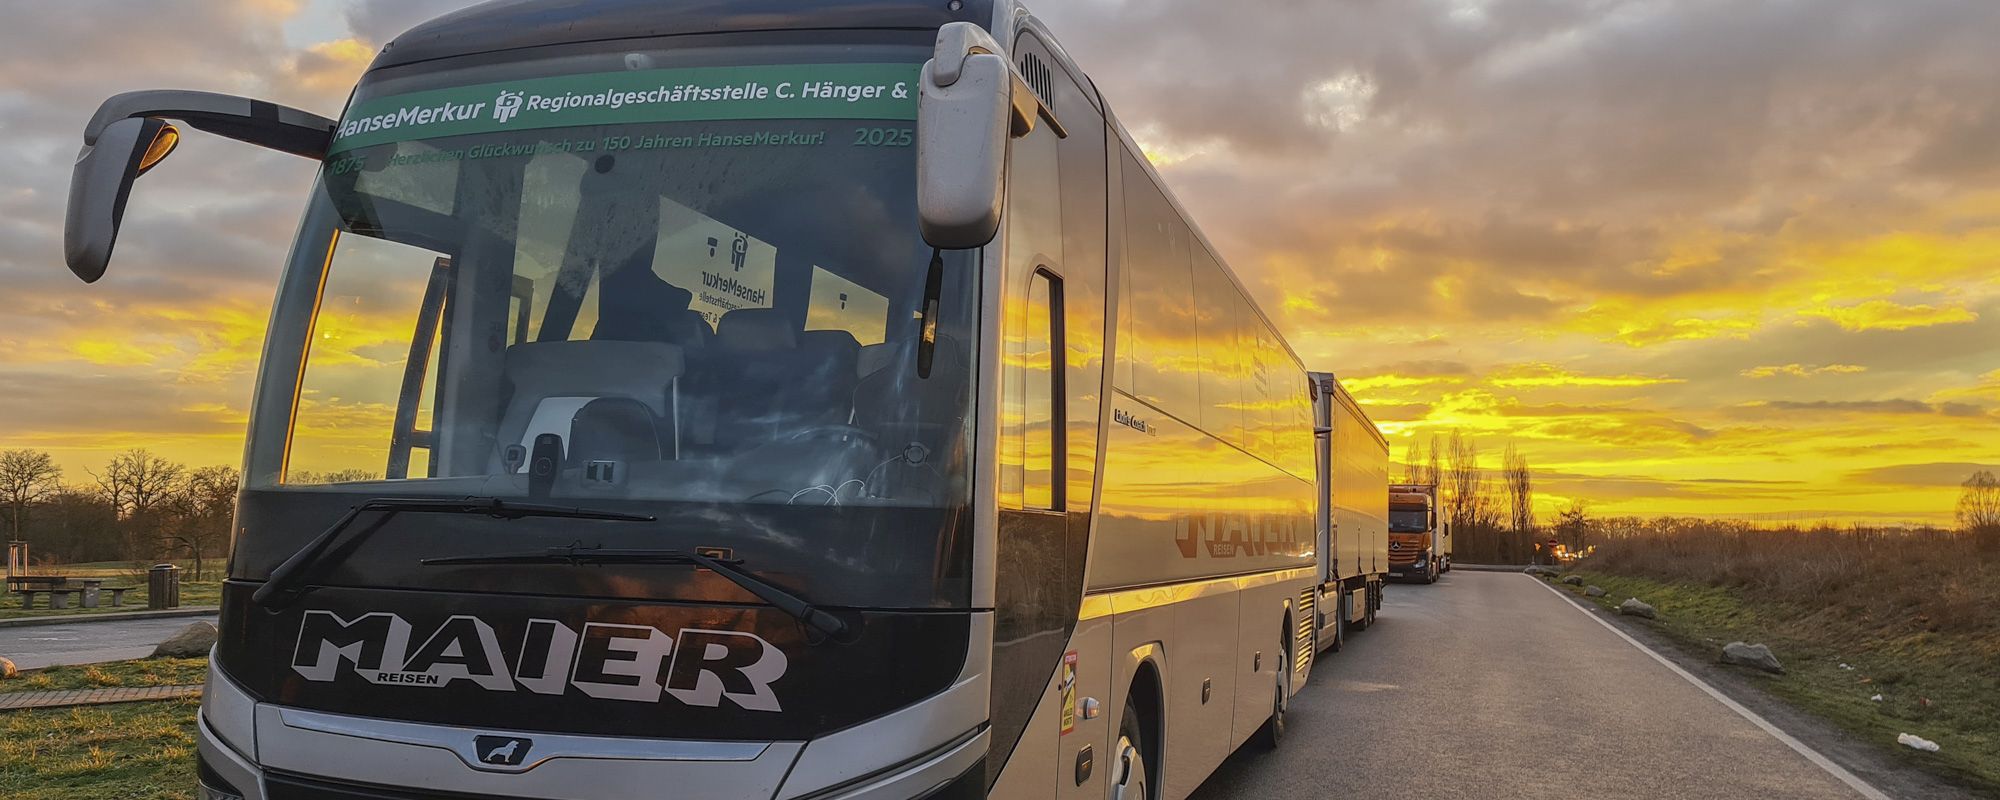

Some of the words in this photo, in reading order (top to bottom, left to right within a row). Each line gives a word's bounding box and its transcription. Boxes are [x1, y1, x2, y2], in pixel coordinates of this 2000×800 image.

[333, 102, 485, 143] HanseMerkur
[526, 82, 768, 112] Regionalgeschäftsstelle
[776, 83, 795, 99] C.
[802, 81, 885, 102] Hänger
[891, 82, 908, 99] &
[469, 139, 571, 160] Glückwunsch
[576, 140, 595, 152] zu
[603, 135, 631, 151] 150
[634, 134, 693, 150] Jahren
[698, 130, 826, 148] HanseMerkur!
[852, 127, 912, 147] 2025
[328, 154, 367, 176] 1875
[290, 609, 789, 712] MAIER
[377, 671, 440, 685] REISEN
